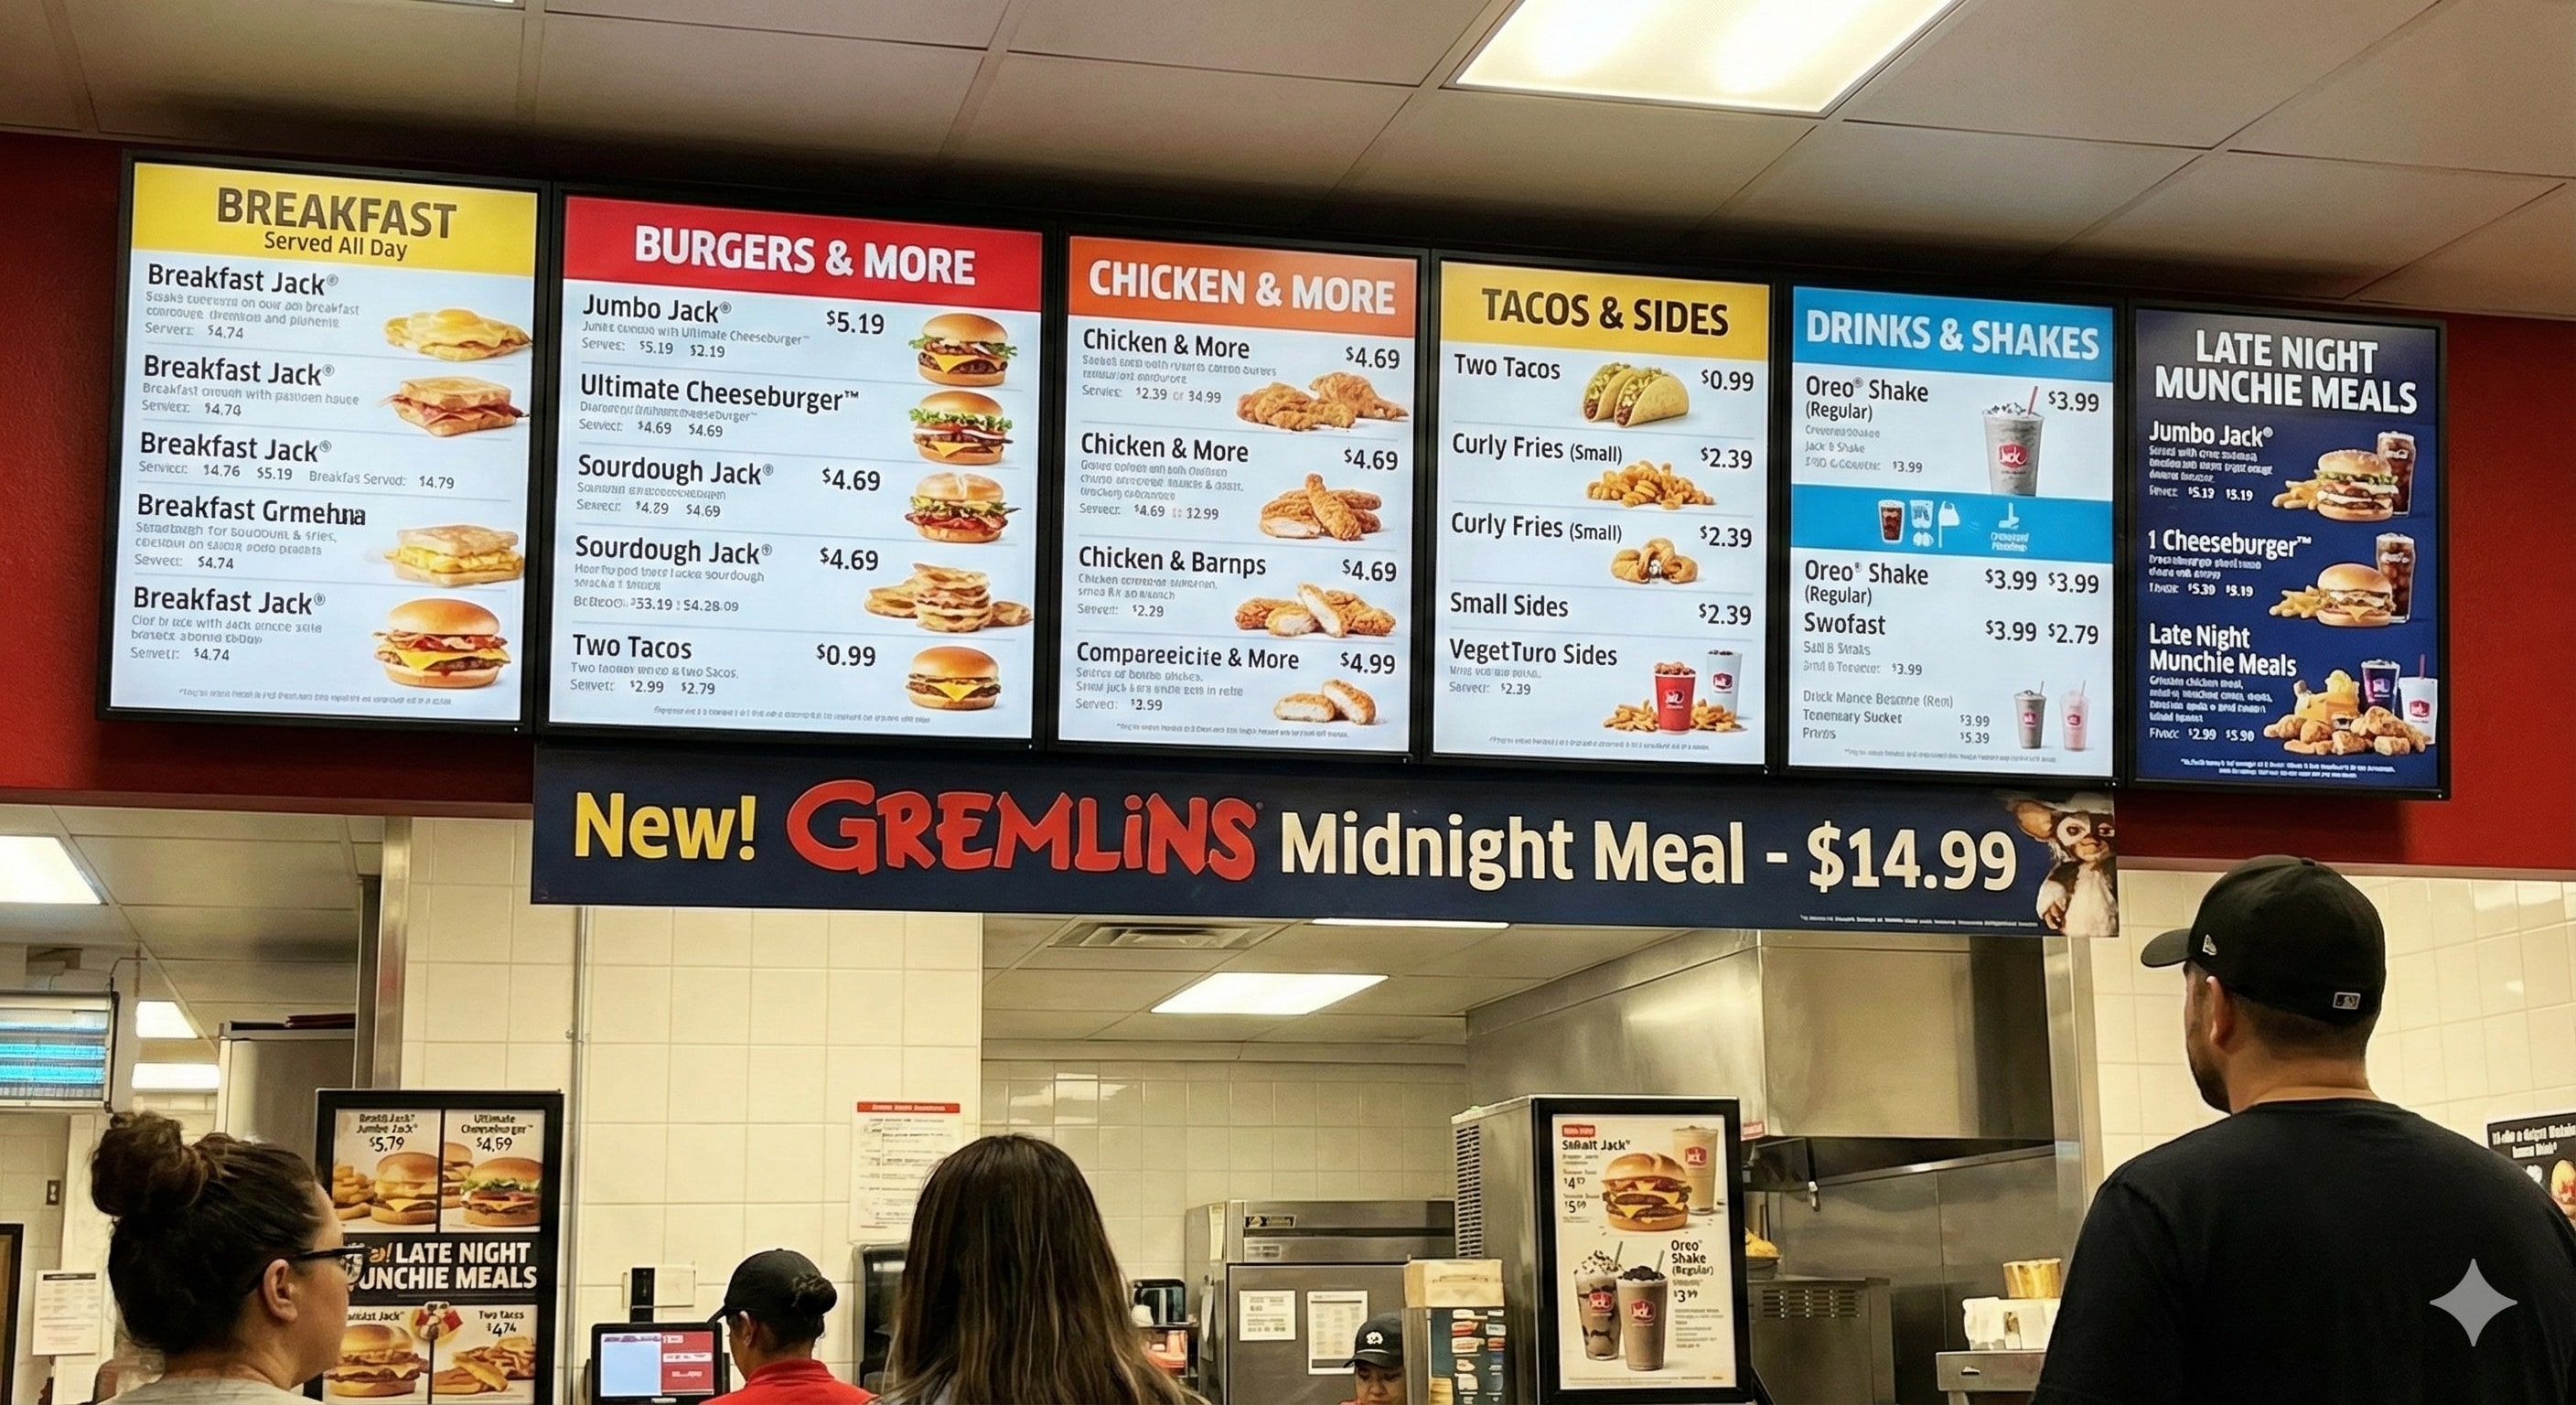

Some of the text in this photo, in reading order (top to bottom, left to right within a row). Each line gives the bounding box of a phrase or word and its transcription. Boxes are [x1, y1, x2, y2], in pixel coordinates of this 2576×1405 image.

[218, 187, 456, 239] BREAKFAST
[264, 231, 407, 261] Served All Day
[635, 224, 976, 286] BURGERS & MORE
[148, 263, 263, 292] Breakfast
[1089, 260, 1395, 314] CHICKEN & MORE
[583, 294, 660, 320] Jumbo
[826, 311, 885, 336] $5.19
[1482, 287, 1729, 337] TACOS & SIDES
[1083, 328, 1400, 370] Chicken & More $4.69
[1807, 309, 2099, 360] DRINKS & SHAKES
[639, 340, 673, 354] $5.19
[690, 344, 724, 359] $2.19
[2196, 329, 2377, 373] LATE NIGHT
[144, 356, 261, 382] Breakfast
[1454, 353, 1754, 391] Two Tacos $0.99
[581, 373, 679, 401] Ultimate
[1868, 379, 1929, 402] Shake
[2048, 391, 2099, 413] $3.99
[2155, 366, 2417, 413] MUNCHIE MEALS
[1805, 401, 1873, 423] (Regular)
[639, 421, 723, 437] $4.69 $4.69
[2149, 421, 2215, 445] Jumbo
[140, 432, 257, 459] Breakfast
[1081, 433, 1398, 471] Chicken & More $4.69
[1453, 432, 1753, 469] Curly Fries (Small) $2.39
[257, 467, 293, 480] $5.19
[578, 454, 703, 485] Sourdough
[822, 467, 880, 491] $4.69
[138, 493, 254, 521] Breakfast
[686, 504, 721, 517] $4.69
[1451, 512, 1753, 548] Curly Fries (Small) $2.39
[2149, 530, 2155, 549] 1
[198, 556, 233, 570] $4.74
[575, 535, 701, 566] Sourdough
[820, 547, 878, 571] $4.69
[1079, 546, 1163, 570] Chicken
[1170, 551, 1185, 571] &
[1343, 559, 1397, 583] $4.69
[1868, 562, 1929, 585] Shake
[1985, 568, 2037, 591] $3.99
[2048, 571, 2099, 594] $3.99
[134, 586, 252, 612] Breakfast
[1450, 592, 1752, 625] Small Sides $2.39
[1805, 585, 1873, 606] (Regular)
[1804, 612, 2098, 644] Swofast $3.99 $2.79
[2150, 623, 2249, 651] Late Night
[194, 648, 230, 661] $4.74
[573, 634, 875, 667] Two Tacos $0.99
[1229, 648, 1241, 667] &
[1248, 649, 1299, 670] More
[1340, 651, 1395, 675] $4.99
[1563, 643, 1617, 666] Sides
[2150, 649, 2296, 678] Munchie Meals
[630, 680, 715, 695] $2.99 $2.79
[1501, 682, 1531, 695] $2.39
[1960, 714, 1990, 727] $3.99
[574, 791, 756, 861] New!
[1282, 810, 1573, 892] Midnight
[1595, 820, 1744, 885] Meal
[1808, 821, 2016, 895] $14.99
[396, 1242, 531, 1263] LATE NIGHT
[1671, 1253, 1706, 1264] Shake
[456, 1266, 537, 1290] MEALS
